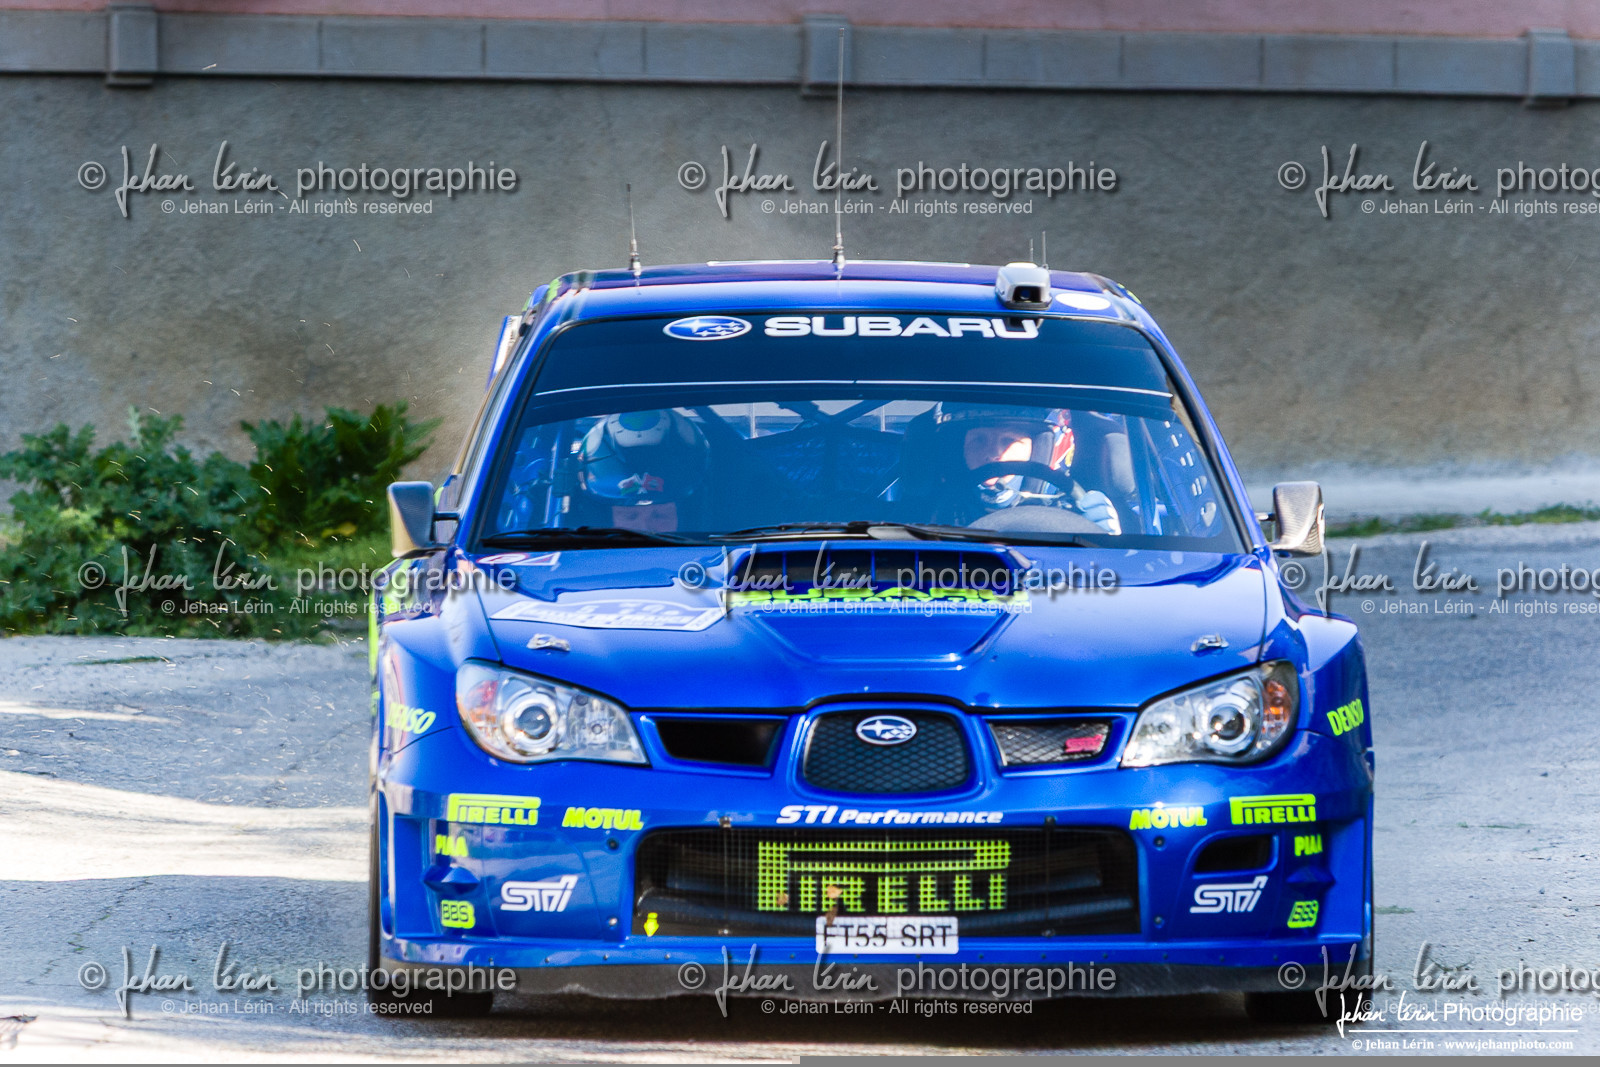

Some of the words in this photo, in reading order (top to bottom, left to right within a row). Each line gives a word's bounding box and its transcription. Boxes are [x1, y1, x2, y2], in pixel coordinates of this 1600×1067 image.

[765, 316, 1039, 339] SUBARU
[1326, 698, 1364, 736] DENSO
[447, 793, 541, 825] PIRELLI
[562, 807, 644, 830] MOTUL
[776, 805, 838, 824] STI
[838, 809, 1004, 824] Performance
[1129, 807, 1207, 830] MOTUL
[1229, 794, 1316, 825] PIRELLI
[758, 841, 1011, 912] PIRELLI
[901, 924, 952, 947] SRT
